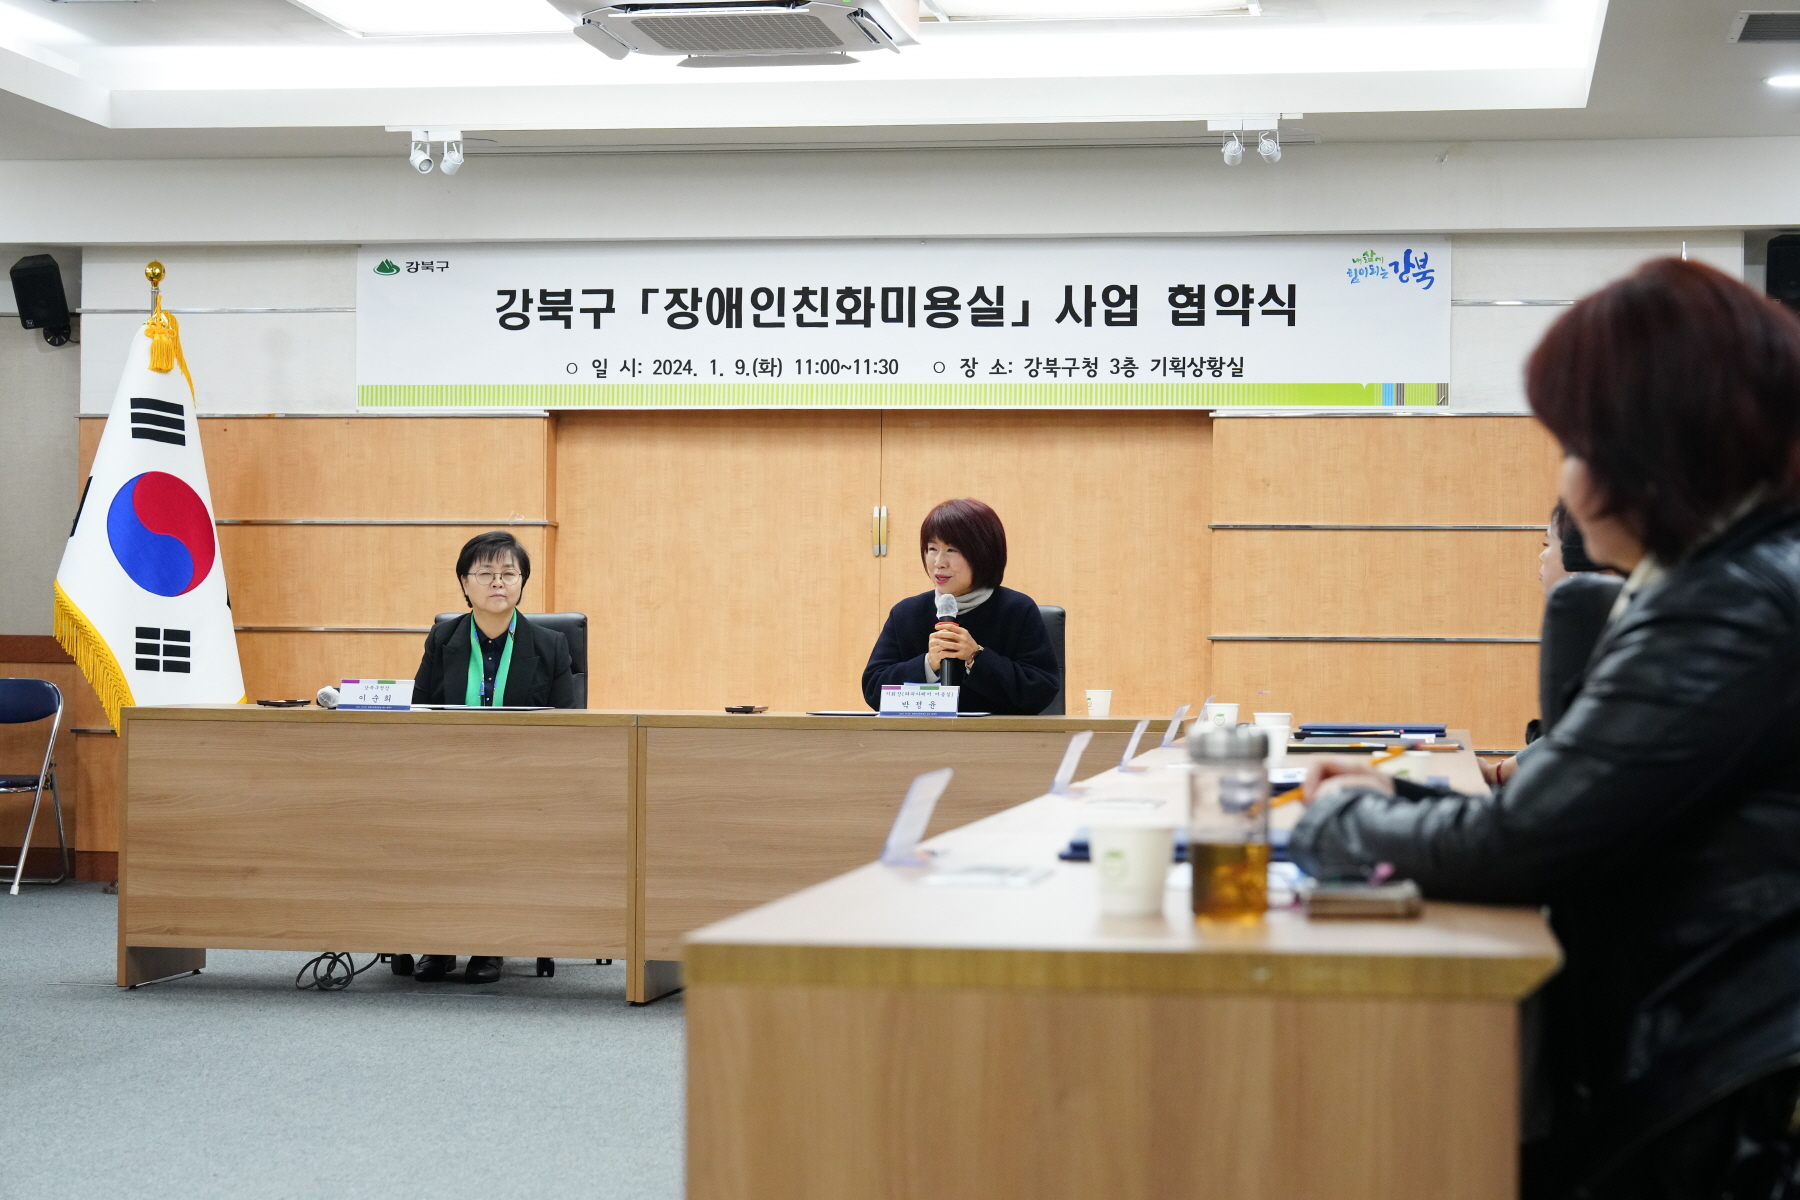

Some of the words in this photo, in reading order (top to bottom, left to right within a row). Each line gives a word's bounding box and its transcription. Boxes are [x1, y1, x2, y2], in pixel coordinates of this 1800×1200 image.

[405, 260, 450, 274] 강북구
[1388, 248, 1436, 291] 강북
[495, 288, 616, 331] 강북구
[641, 285, 1030, 330] 「장애인친화미용실」
[1054, 284, 1138, 328] 사업
[1167, 283, 1297, 327] 협약식
[591, 358, 608, 379] 일
[619, 358, 643, 378] 시:
[652, 359, 698, 377] 2024.
[710, 359, 724, 377] 1.
[735, 357, 783, 378] 9.(화)
[795, 358, 899, 376] 11:00~11:30
[959, 357, 979, 379] 장
[988, 357, 1013, 376] 소:
[1023, 356, 1098, 378] 강북구청
[1109, 356, 1139, 379] 3층
[1150, 356, 1245, 378] 기획상황실
